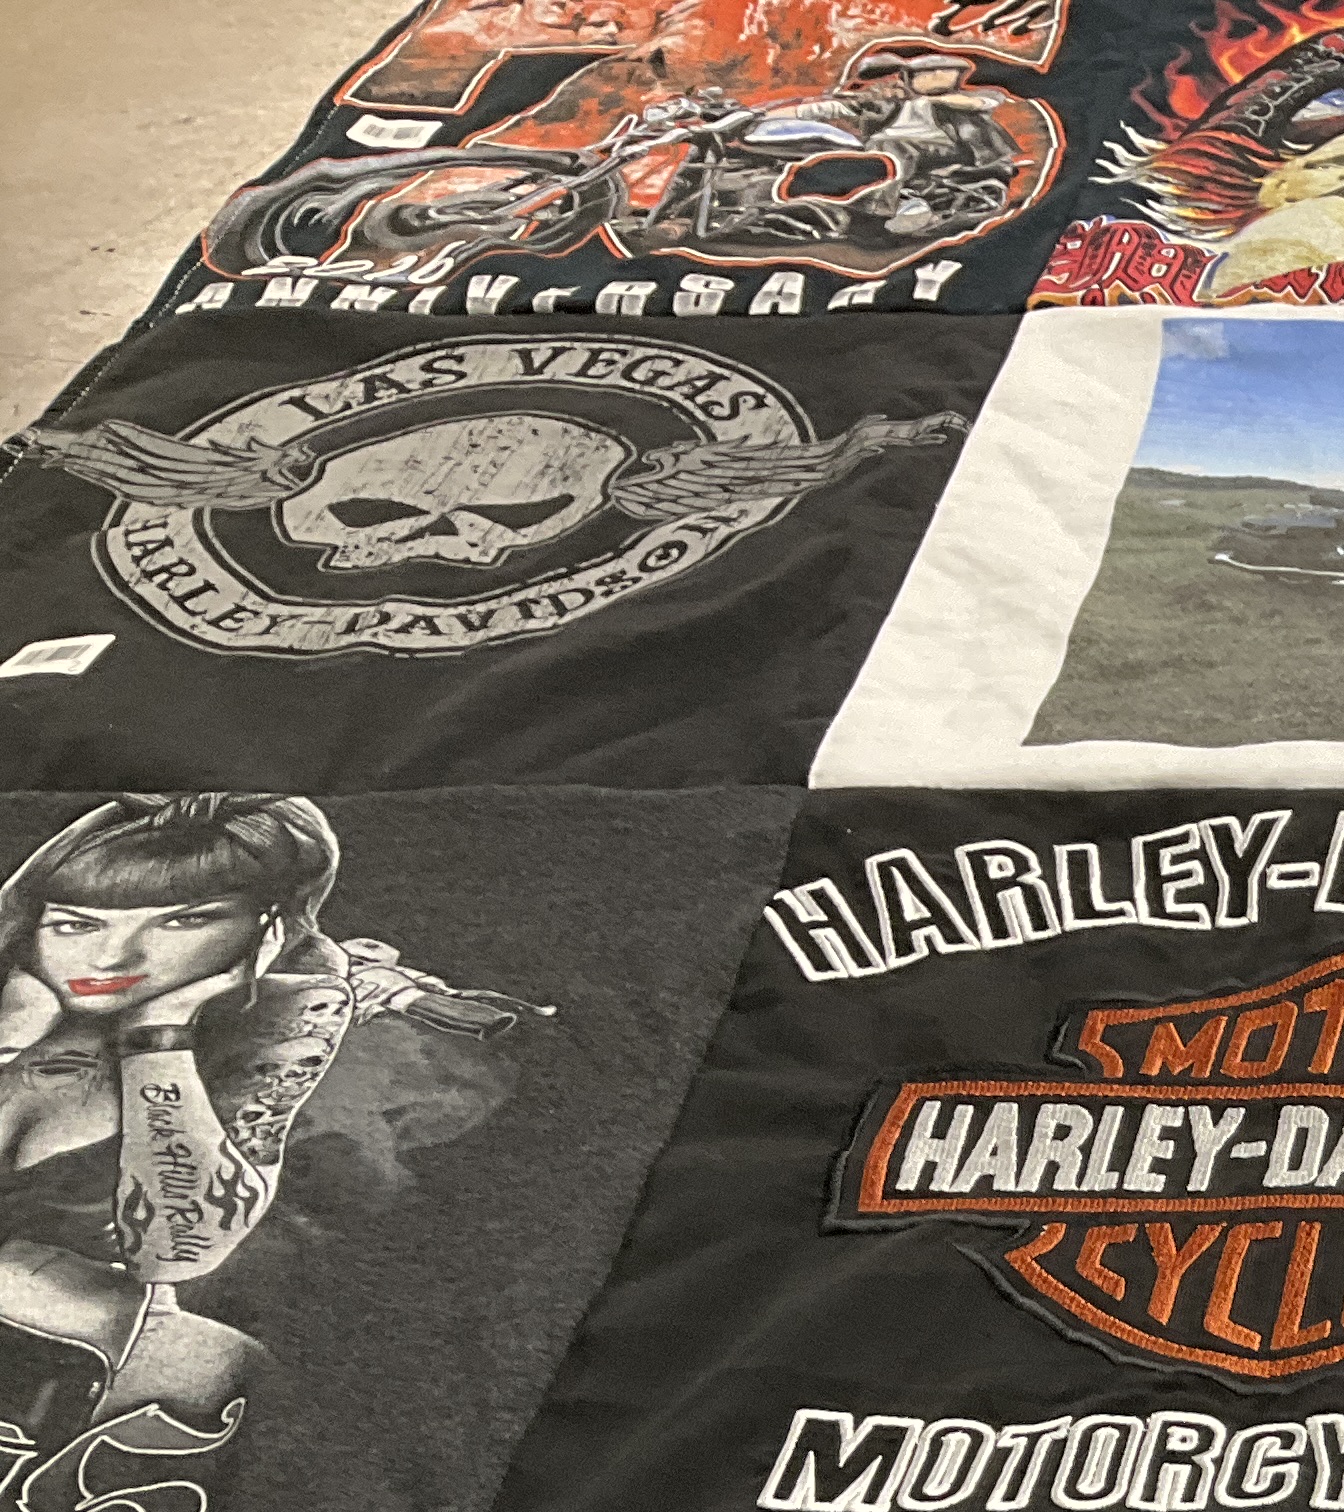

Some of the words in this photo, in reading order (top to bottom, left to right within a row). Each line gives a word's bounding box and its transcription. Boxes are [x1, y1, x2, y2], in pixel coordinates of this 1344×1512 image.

[279, 353, 468, 424] LAS
[514, 346, 771, 427] VEGAS
[123, 508, 751, 641] HARLEY-DAVIDSON
